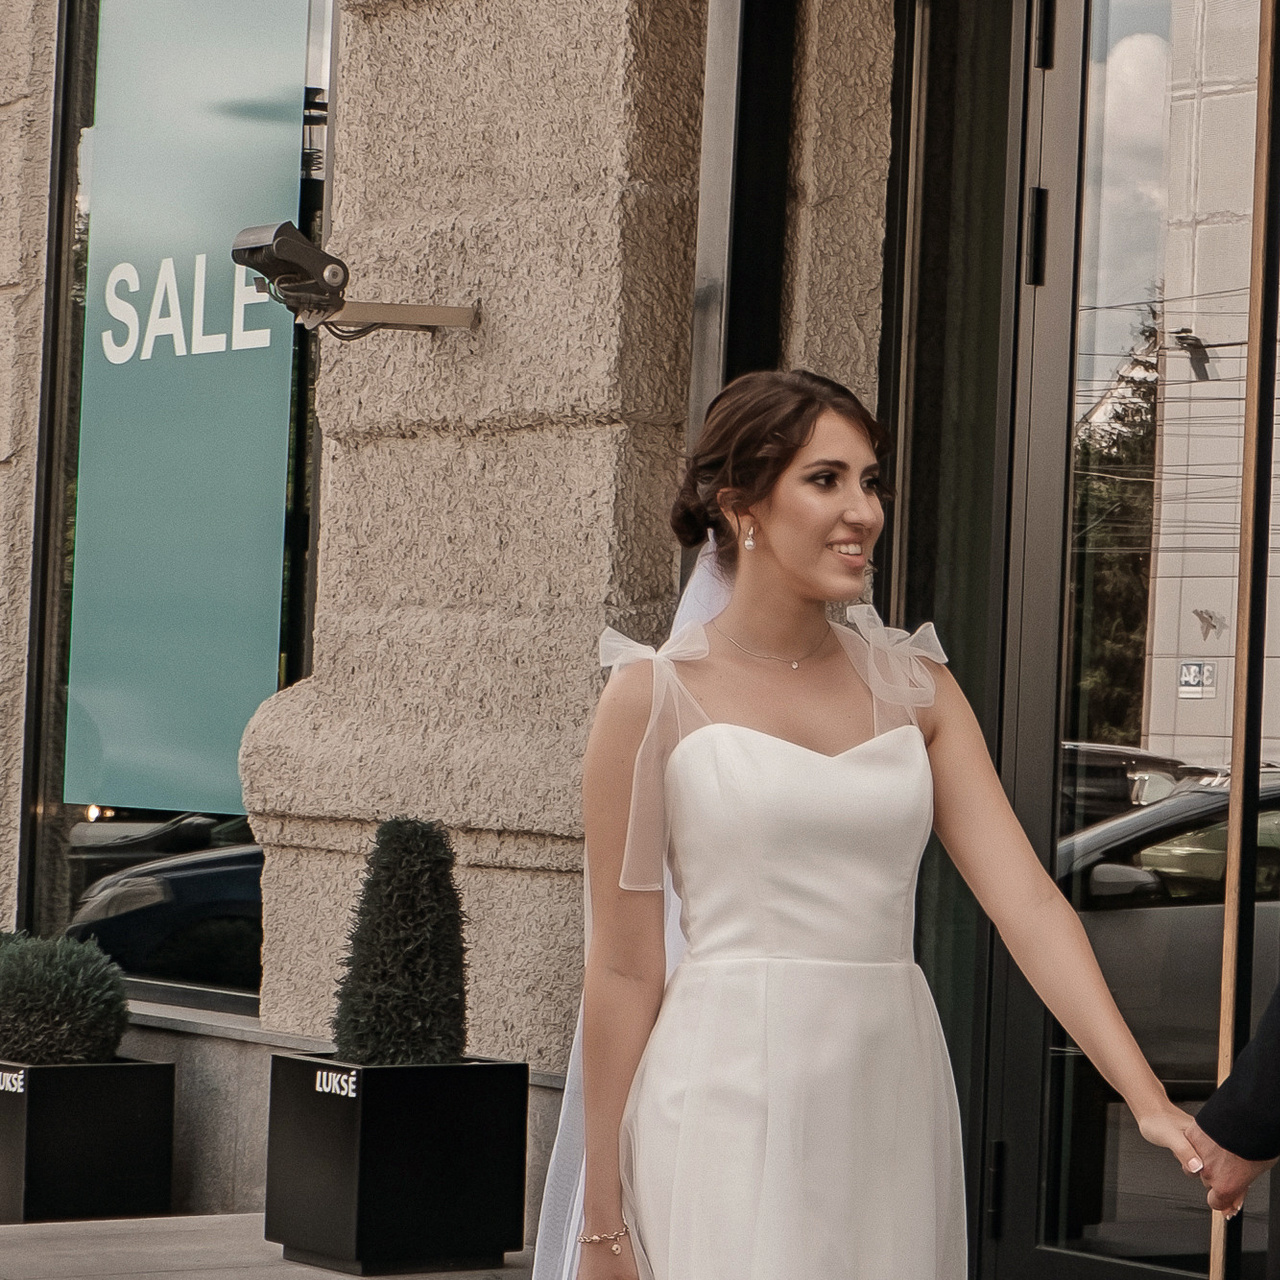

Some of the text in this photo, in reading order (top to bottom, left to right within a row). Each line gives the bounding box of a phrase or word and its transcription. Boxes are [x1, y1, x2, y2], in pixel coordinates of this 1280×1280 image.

[102, 254, 271, 365] SALE
[0, 1070, 24, 1093] UKSÉ
[315, 1070, 357, 1098] LUKSÉ
